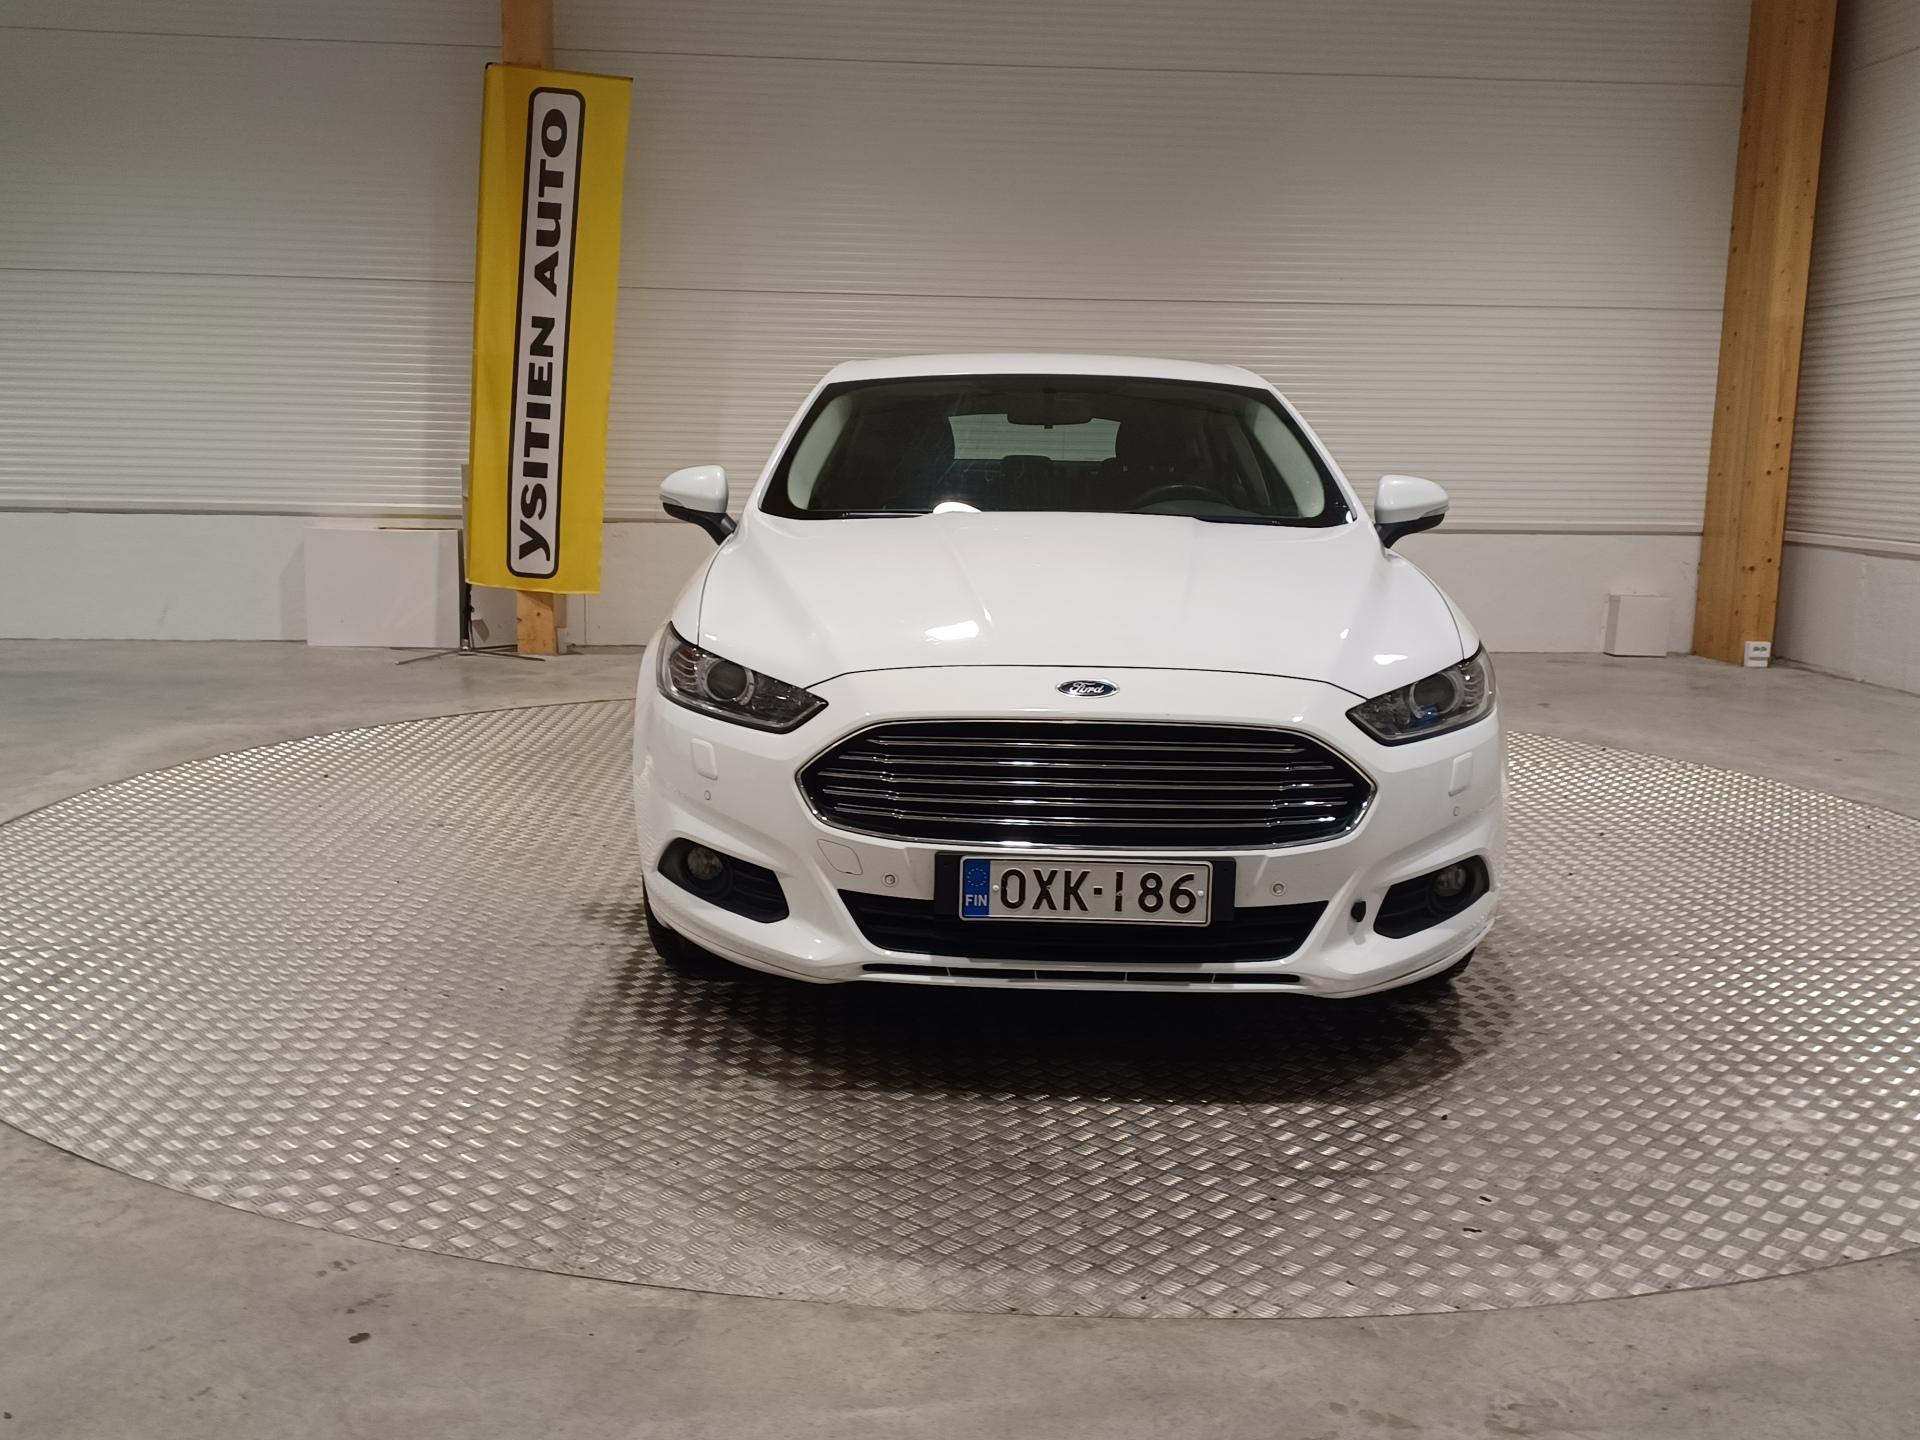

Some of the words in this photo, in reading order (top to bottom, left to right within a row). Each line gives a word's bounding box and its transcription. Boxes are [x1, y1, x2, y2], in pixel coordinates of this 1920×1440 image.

[534, 108, 568, 297] AUTO
[1069, 681, 1105, 695] Ford
[965, 894, 988, 907] FIN
[1000, 868, 1197, 914] OXK-186
